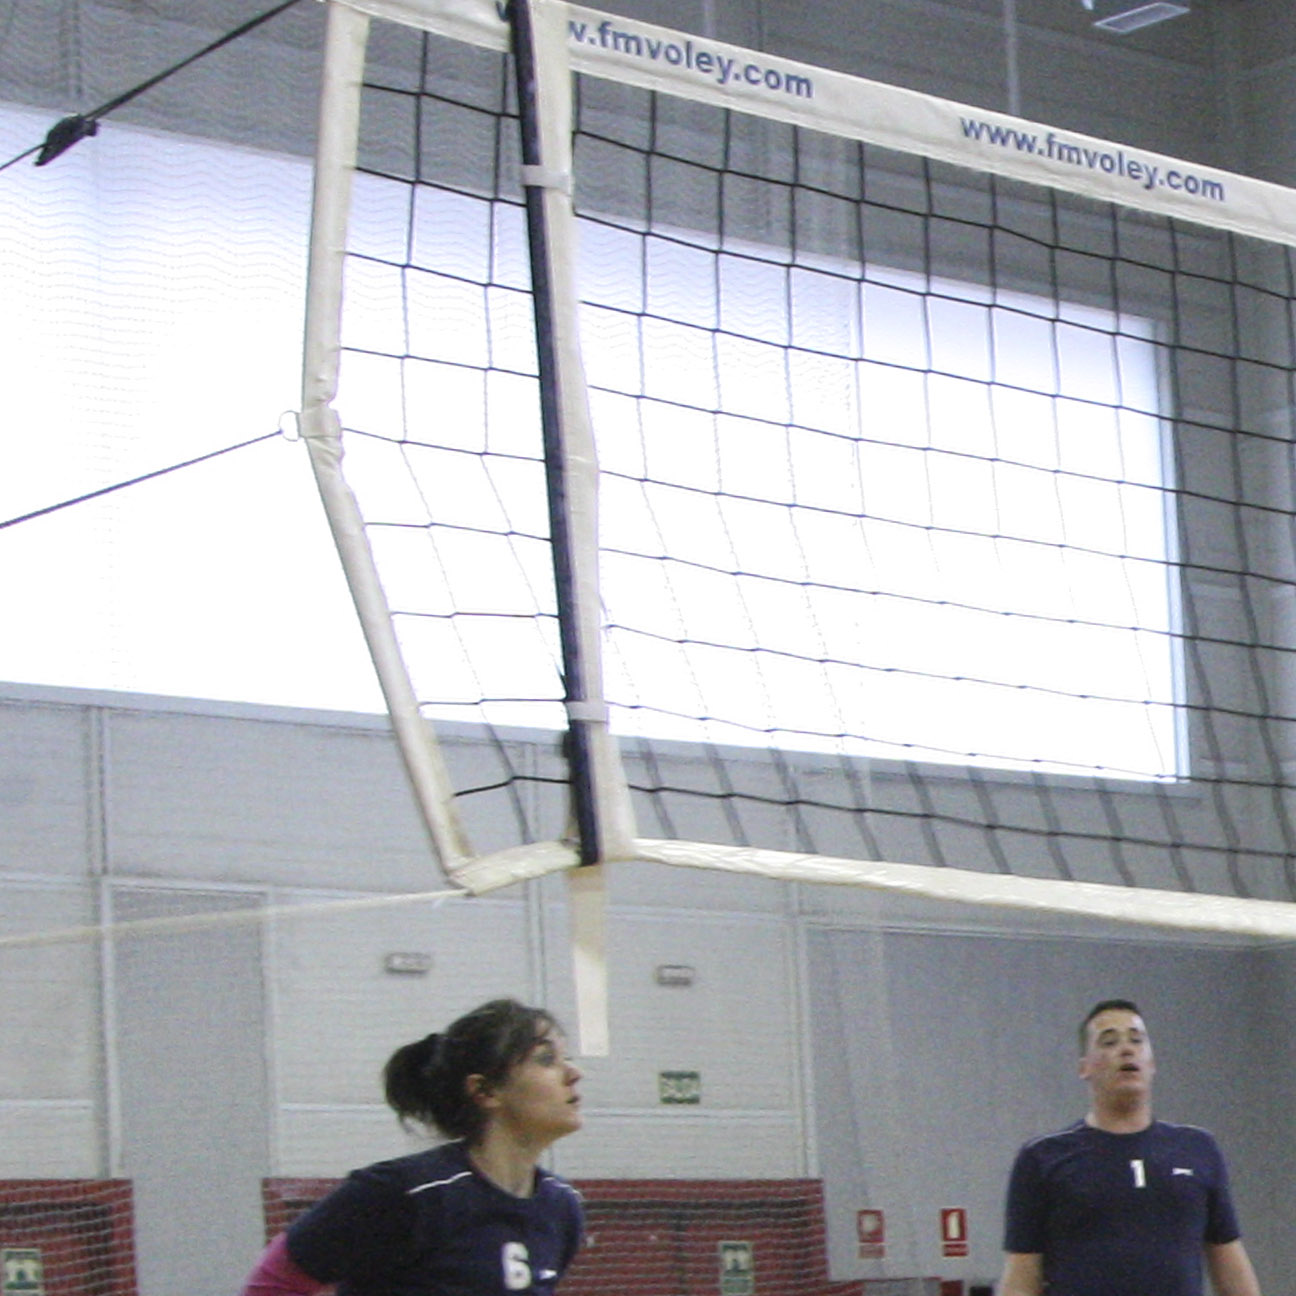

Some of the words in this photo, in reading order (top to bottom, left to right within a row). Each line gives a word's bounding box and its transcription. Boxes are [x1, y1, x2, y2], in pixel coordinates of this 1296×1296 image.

[960, 117, 1225, 201] www.fmvoley.com
[1130, 1160, 1146, 1188] 1
[502, 1241, 531, 1290] 6
